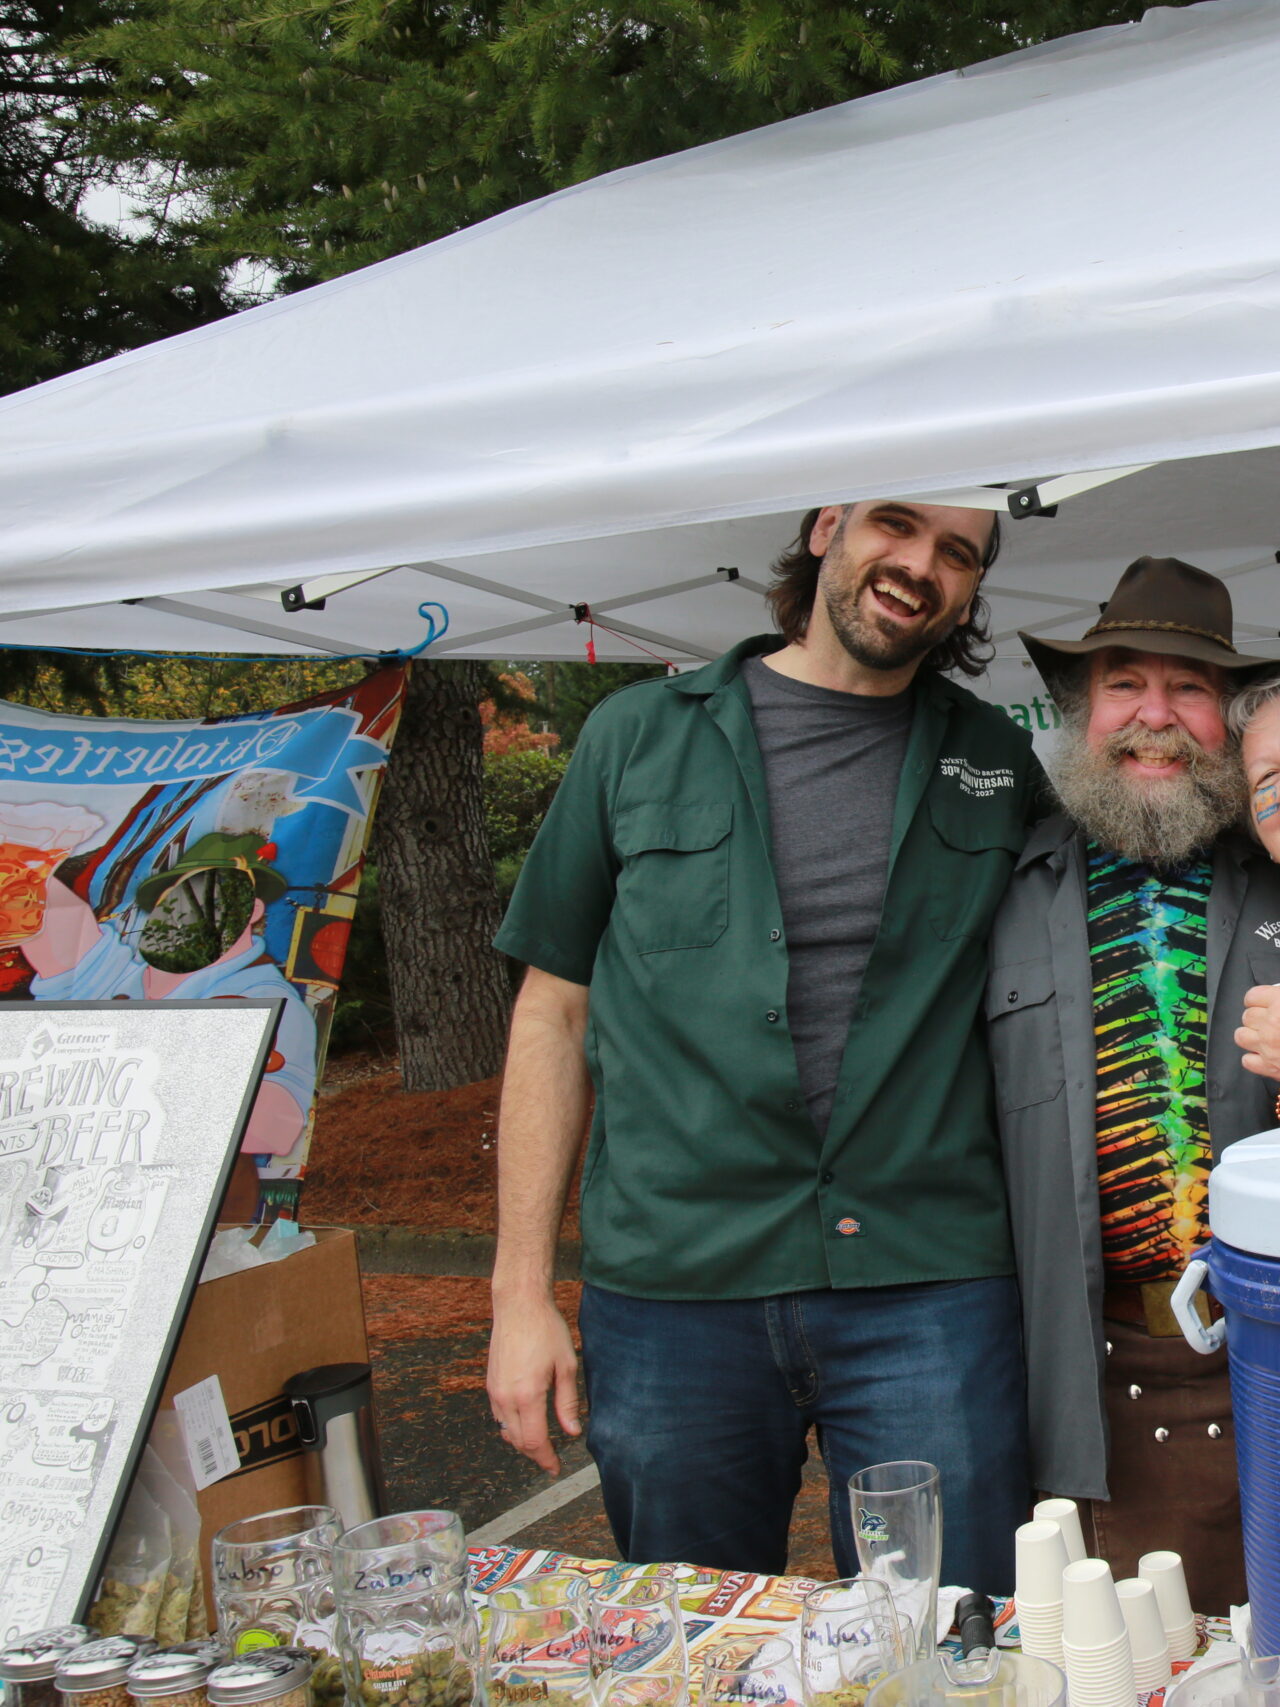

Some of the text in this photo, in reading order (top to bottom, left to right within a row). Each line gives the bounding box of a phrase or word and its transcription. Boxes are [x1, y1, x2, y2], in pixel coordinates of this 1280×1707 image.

[960, 768, 1014, 789] ANNIVERSARY
[36, 1109, 152, 1169] BEER
[38, 1254, 79, 1266] ENZYMES
[373, 1679, 407, 1689] SILVER CITY
